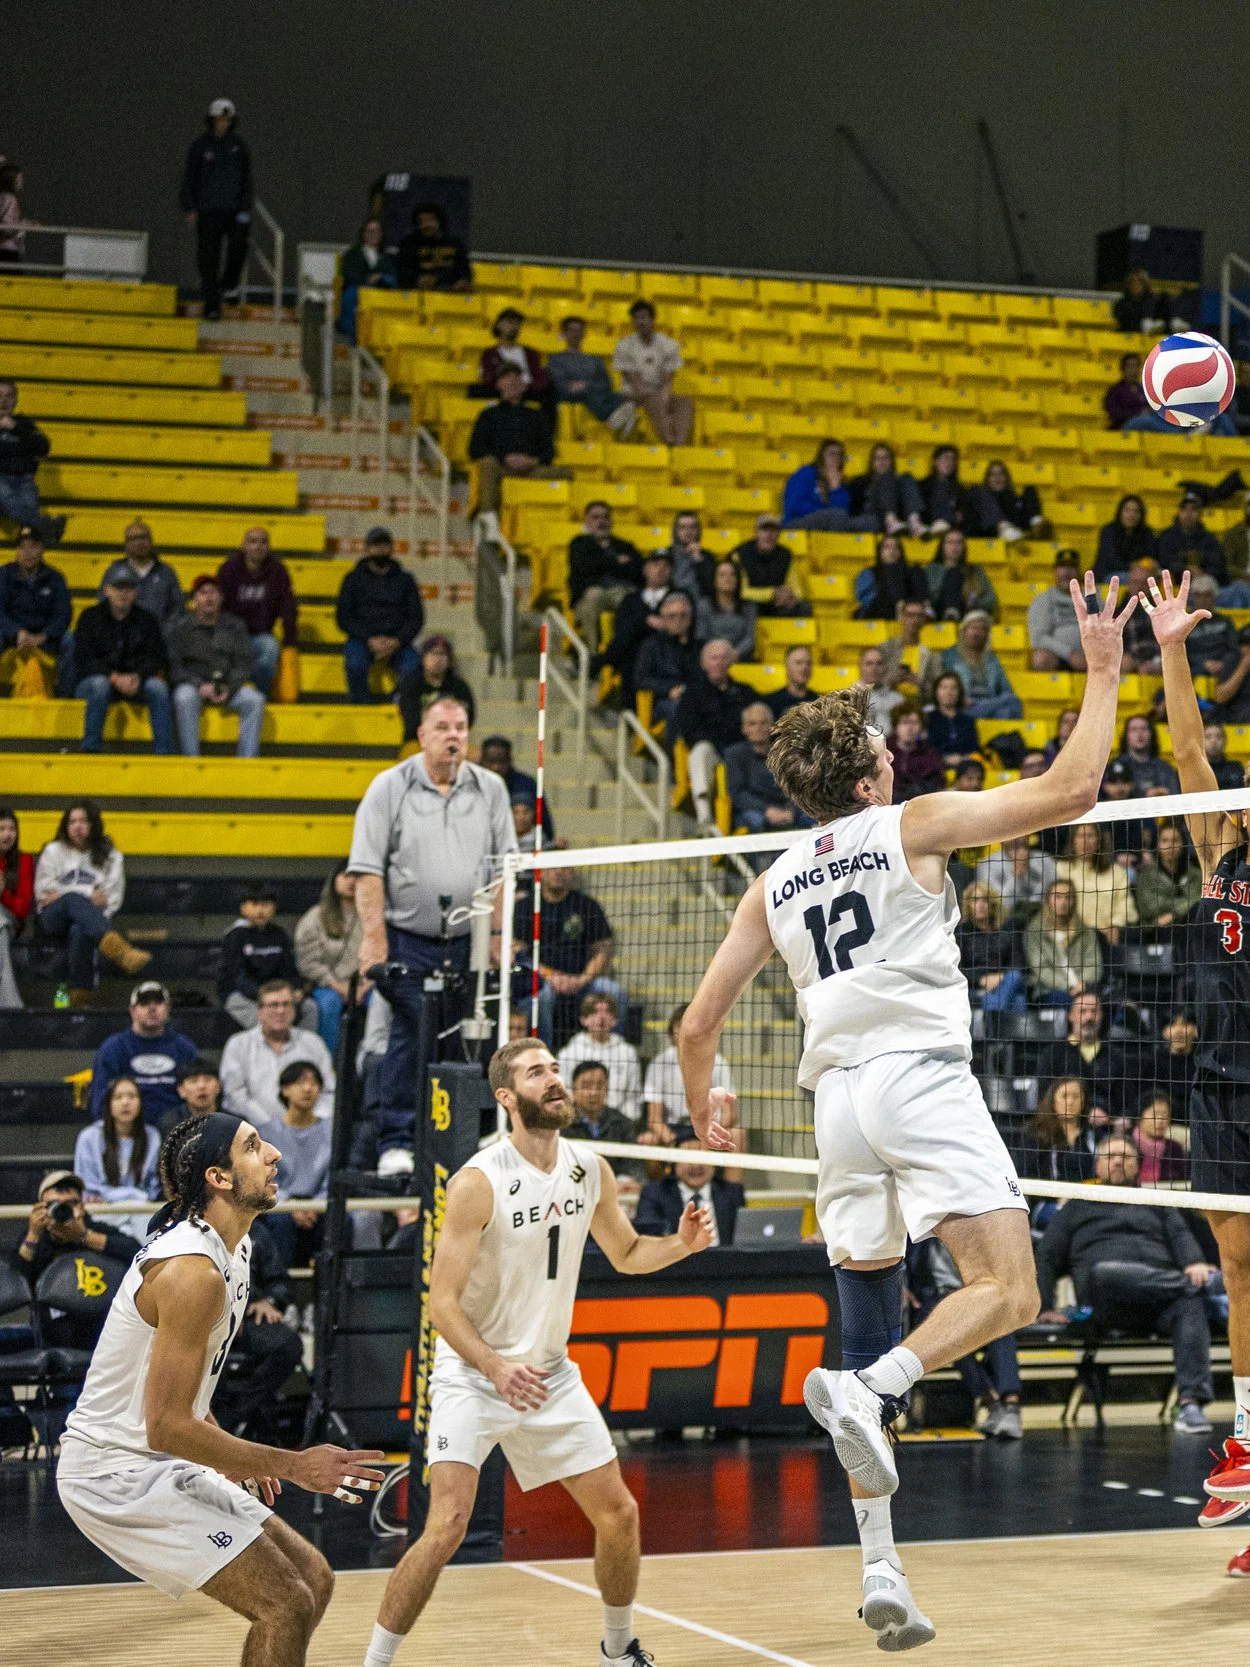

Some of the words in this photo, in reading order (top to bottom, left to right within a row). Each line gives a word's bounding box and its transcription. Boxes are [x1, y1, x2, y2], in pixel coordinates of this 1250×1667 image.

[772, 867, 825, 910] LONG
[827, 852, 891, 881] BEACH
[803, 889, 887, 981] 12
[1214, 908, 1243, 955] 3
[546, 1224, 560, 1280] 1
